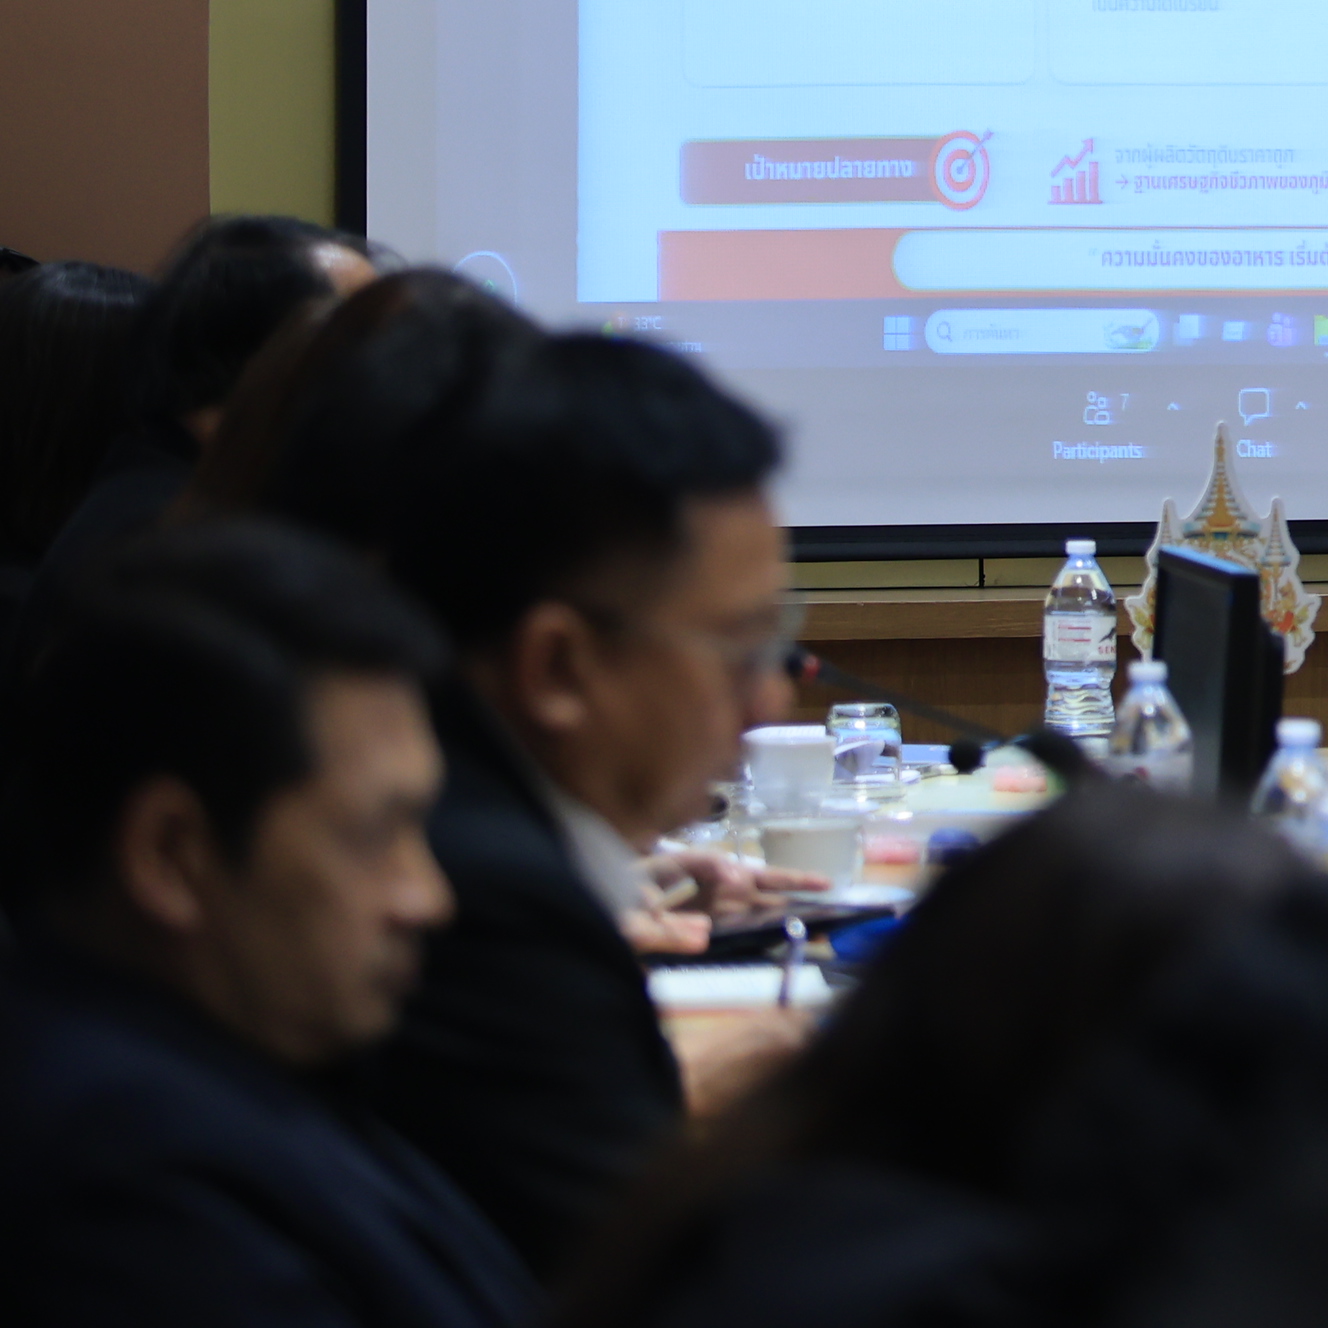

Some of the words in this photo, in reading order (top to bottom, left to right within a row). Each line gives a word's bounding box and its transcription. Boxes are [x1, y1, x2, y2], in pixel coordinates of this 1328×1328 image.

[1120, 393, 1130, 411] 7
[1053, 440, 1142, 462] Participants
[1236, 440, 1272, 459] Chat
